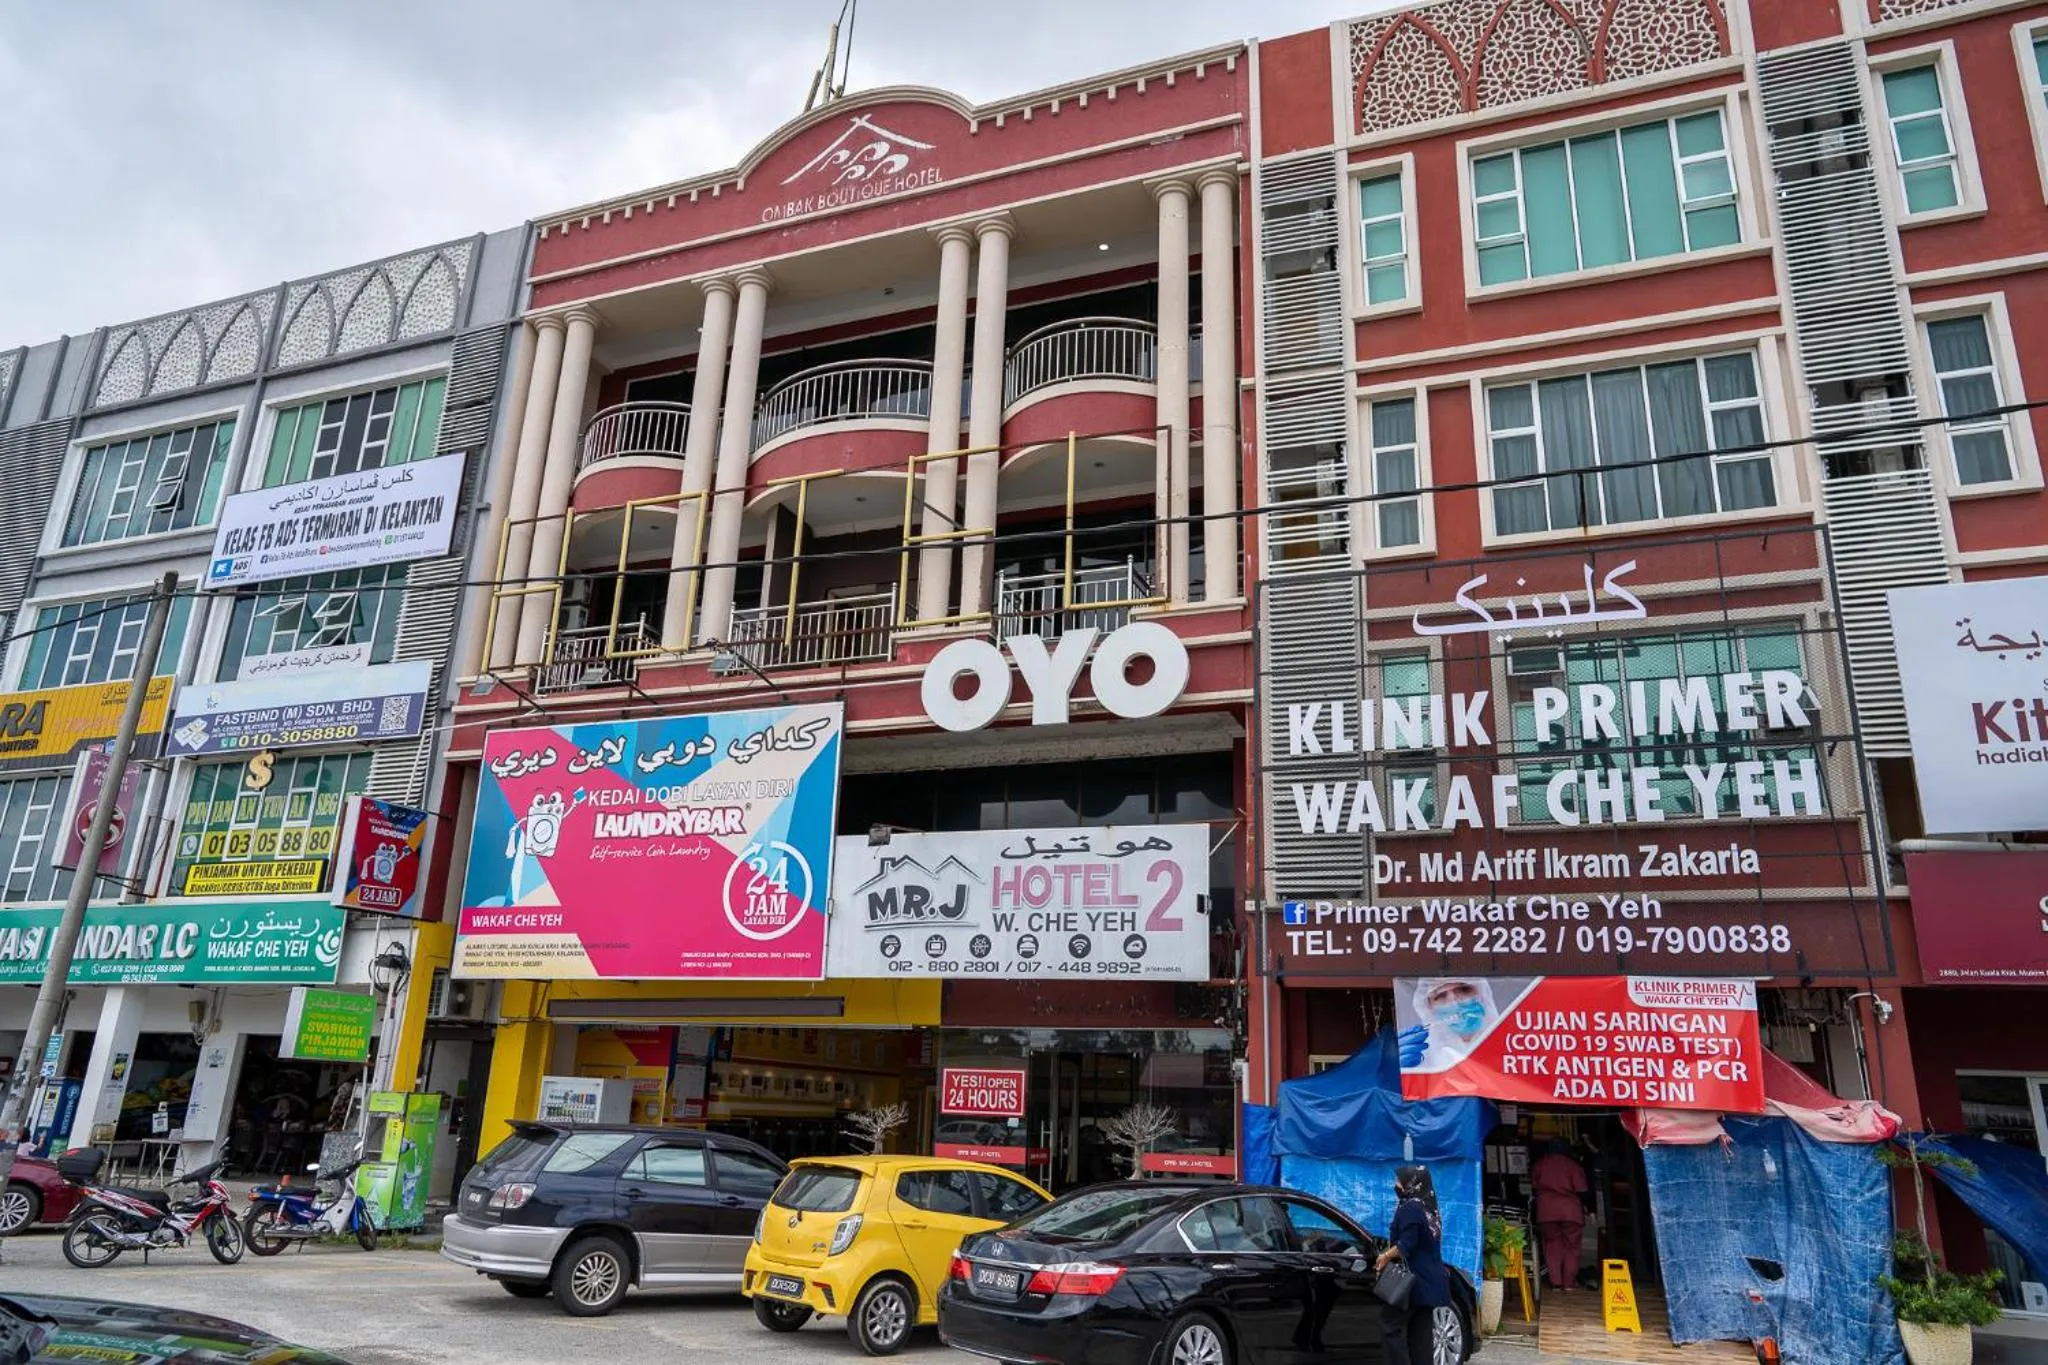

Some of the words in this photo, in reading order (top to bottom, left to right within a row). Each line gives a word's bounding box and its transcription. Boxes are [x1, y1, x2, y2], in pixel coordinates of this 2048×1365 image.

[762, 195, 815, 223] OMBAK
[817, 179, 892, 210] BOUTIQUE
[895, 168, 943, 192] HOTEL
[222, 525, 259, 555] KELAS
[258, 522, 275, 551] FB
[275, 519, 298, 548] ADS
[299, 510, 361, 543] TERMURAH
[363, 504, 379, 535] DI
[379, 496, 445, 531] KELANTAN
[921, 621, 1191, 732] OYO
[214, 709, 279, 726] FASTBIND
[281, 705, 302, 722] (M)
[306, 703, 338, 717] SDN.
[342, 700, 376, 713] BHD.
[1287, 689, 1492, 757] KLINIK
[1531, 669, 1813, 743] PRIMER
[239, 725, 359, 748] 010-3058880
[588, 789, 640, 807] KEDAI
[645, 786, 687, 804] DOBI
[692, 781, 751, 801] LAYAN
[756, 779, 794, 799] DIRI
[1291, 774, 1519, 835] WAKAF
[1545, 766, 1667, 827] CHE
[1682, 758, 1823, 821] YEH
[593, 806, 746, 840] LAUNDRYBAR
[589, 843, 643, 862] Self-service
[646, 843, 666, 858] Coin
[669, 841, 711, 861] Laundry
[193, 864, 241, 879] PINJAMAN
[242, 862, 275, 877] UNTUK
[275, 861, 316, 876] PEKERJA
[1373, 855, 1412, 885] Dr.
[1420, 853, 1464, 884] Md
[1471, 848, 1537, 882] Ariff
[1543, 847, 1631, 879] Ikram
[1639, 842, 1760, 877] Zakaria
[747, 857, 789, 894] 24
[363, 888, 375, 901] 24
[376, 888, 397, 903] JAM
[744, 894, 787, 916] JAM
[991, 862, 1140, 910] HOTEL
[1145, 859, 1184, 932] 2
[743, 916, 768, 925] LAYAN
[770, 916, 786, 925] DIRI
[1315, 901, 1415, 924] Primer
[1421, 897, 1518, 923] Wakaf
[1525, 897, 1591, 921] Che
[1598, 894, 1663, 920] Yeh
[471, 914, 512, 929] WAKAF
[514, 914, 538, 928] CHE
[539, 913, 563, 927] YEH
[992, 912, 1020, 932] W.
[1027, 911, 1078, 932] CHE
[1085, 911, 1137, 932] YEH
[160, 922, 200, 959] LC
[207, 941, 253, 958] WAKAF
[255, 940, 281, 958] CHE
[284, 939, 309, 957] YEH
[1287, 931, 1353, 957] TEL:
[1362, 929, 1465, 955] 09-742
[1473, 928, 1548, 953] 2282
[1574, 925, 1793, 955] 019-7900838
[888, 961, 914, 973] 012
[927, 961, 960, 973] 880
[963, 961, 1001, 973] 2801
[1017, 961, 1044, 973] 017
[1058, 961, 1092, 973] 448
[1097, 961, 1142, 973] 9892
[1634, 981, 1680, 994] KLINIK
[1683, 983, 1737, 995] PRIMER
[1644, 995, 1680, 1005] WAKAF
[1684, 996, 1706, 1005] CHE
[1707, 996, 1729, 1006] YEH
[1515, 1011, 1588, 1031] UJIAN
[1593, 1012, 1727, 1034] SARINGAN
[1505, 1034, 1577, 1052] (COVID
[1582, 1036, 1607, 1052] 19
[1613, 1036, 1676, 1054] SWAB
[1679, 1037, 1742, 1058] TEST)
[1502, 1055, 1549, 1075] RTK
[1553, 1056, 1665, 1078] ANTIGEN
[1671, 1058, 1690, 1079] &
[1697, 1061, 1749, 1082] PCR
[951, 1074, 986, 1088] YES!!
[988, 1078, 1017, 1088] OPEN
[1553, 1079, 1607, 1099] ADA
[1613, 1080, 1638, 1100] DI
[1645, 1081, 1695, 1102] SINI
[949, 1089, 964, 1107] 24
[967, 1089, 1017, 1110] HOURS
